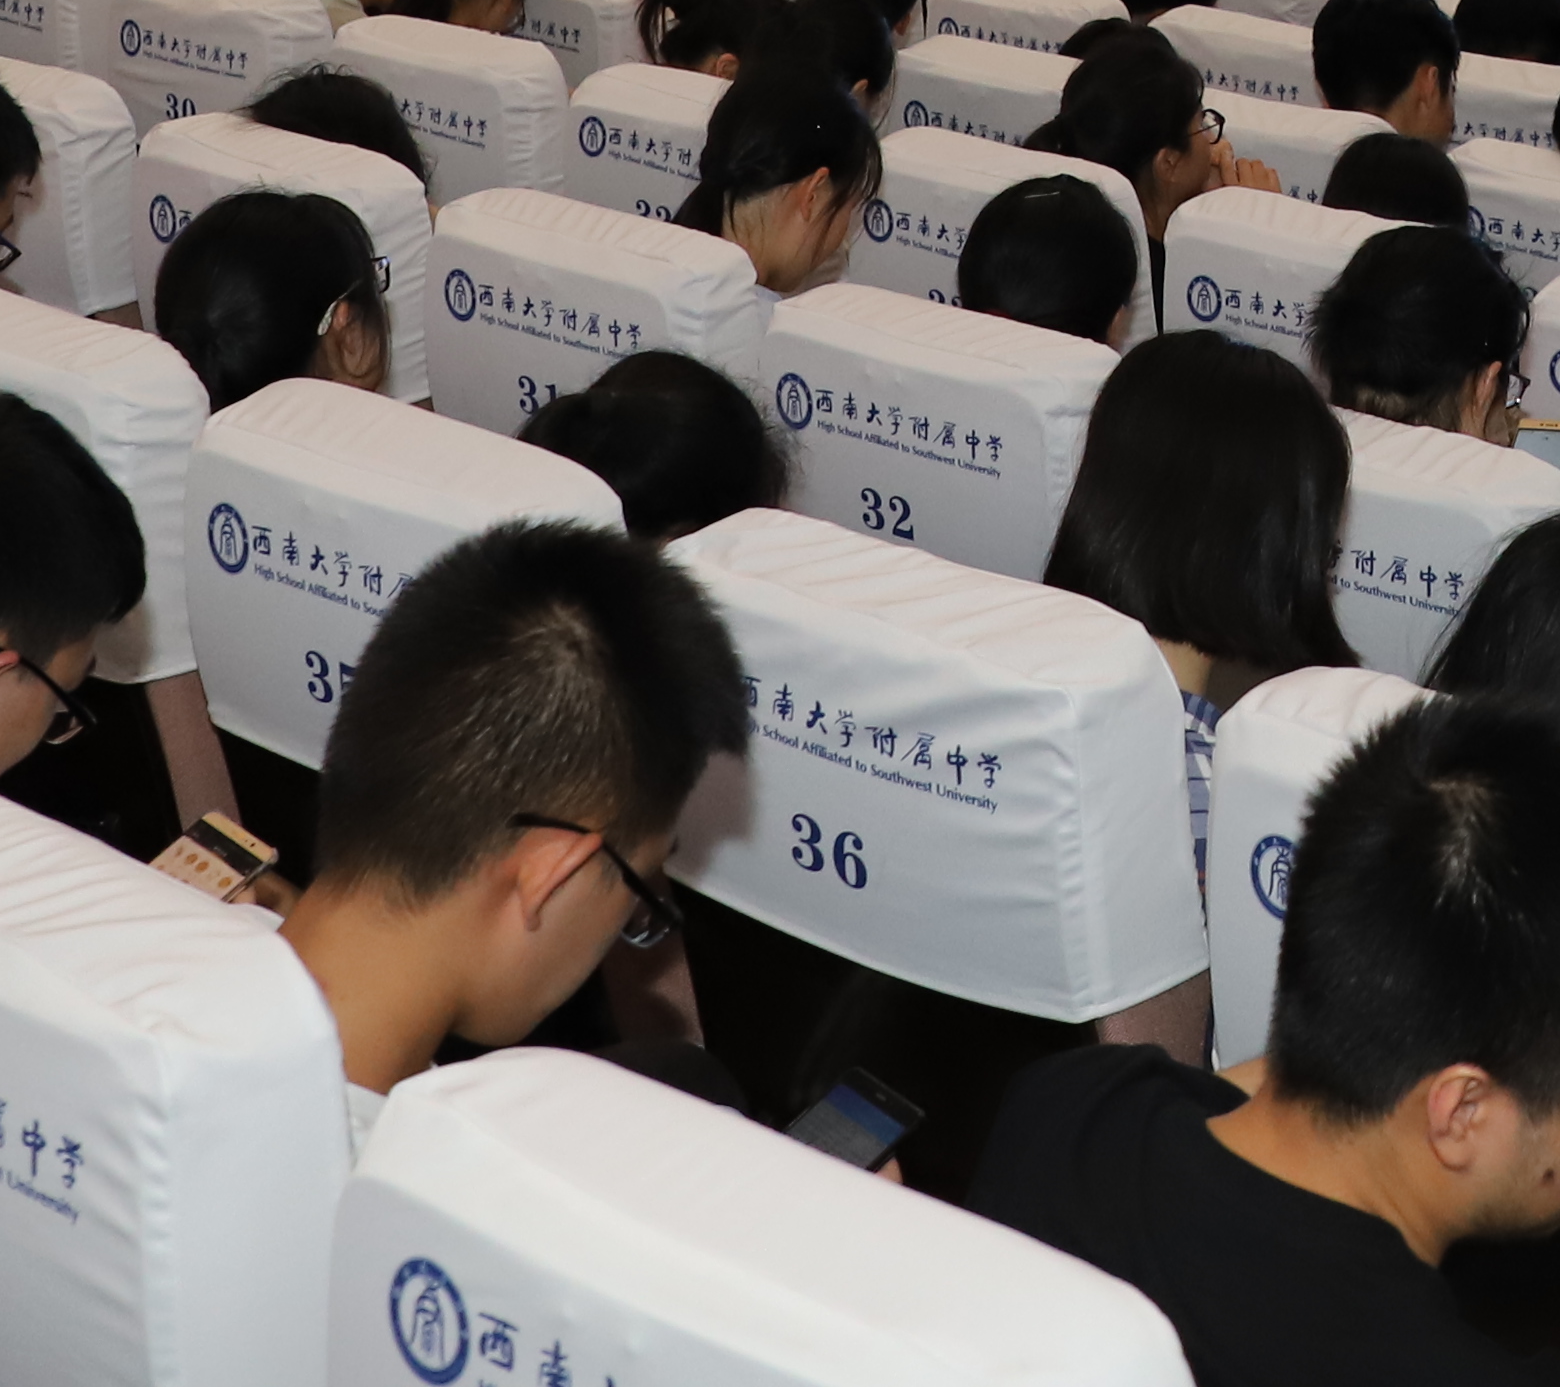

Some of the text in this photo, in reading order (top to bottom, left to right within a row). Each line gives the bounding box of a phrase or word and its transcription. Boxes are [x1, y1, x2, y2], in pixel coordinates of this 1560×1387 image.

[480, 285, 642, 349] 西南大学附属中学
[816, 389, 1003, 462] 西南大学附属中学
[859, 486, 915, 541] 32
[762, 724, 799, 749] School
[802, 735, 853, 769] Affiliated
[870, 760, 933, 796] Southwest
[936, 782, 999, 816] University
[790, 813, 868, 890] 36
